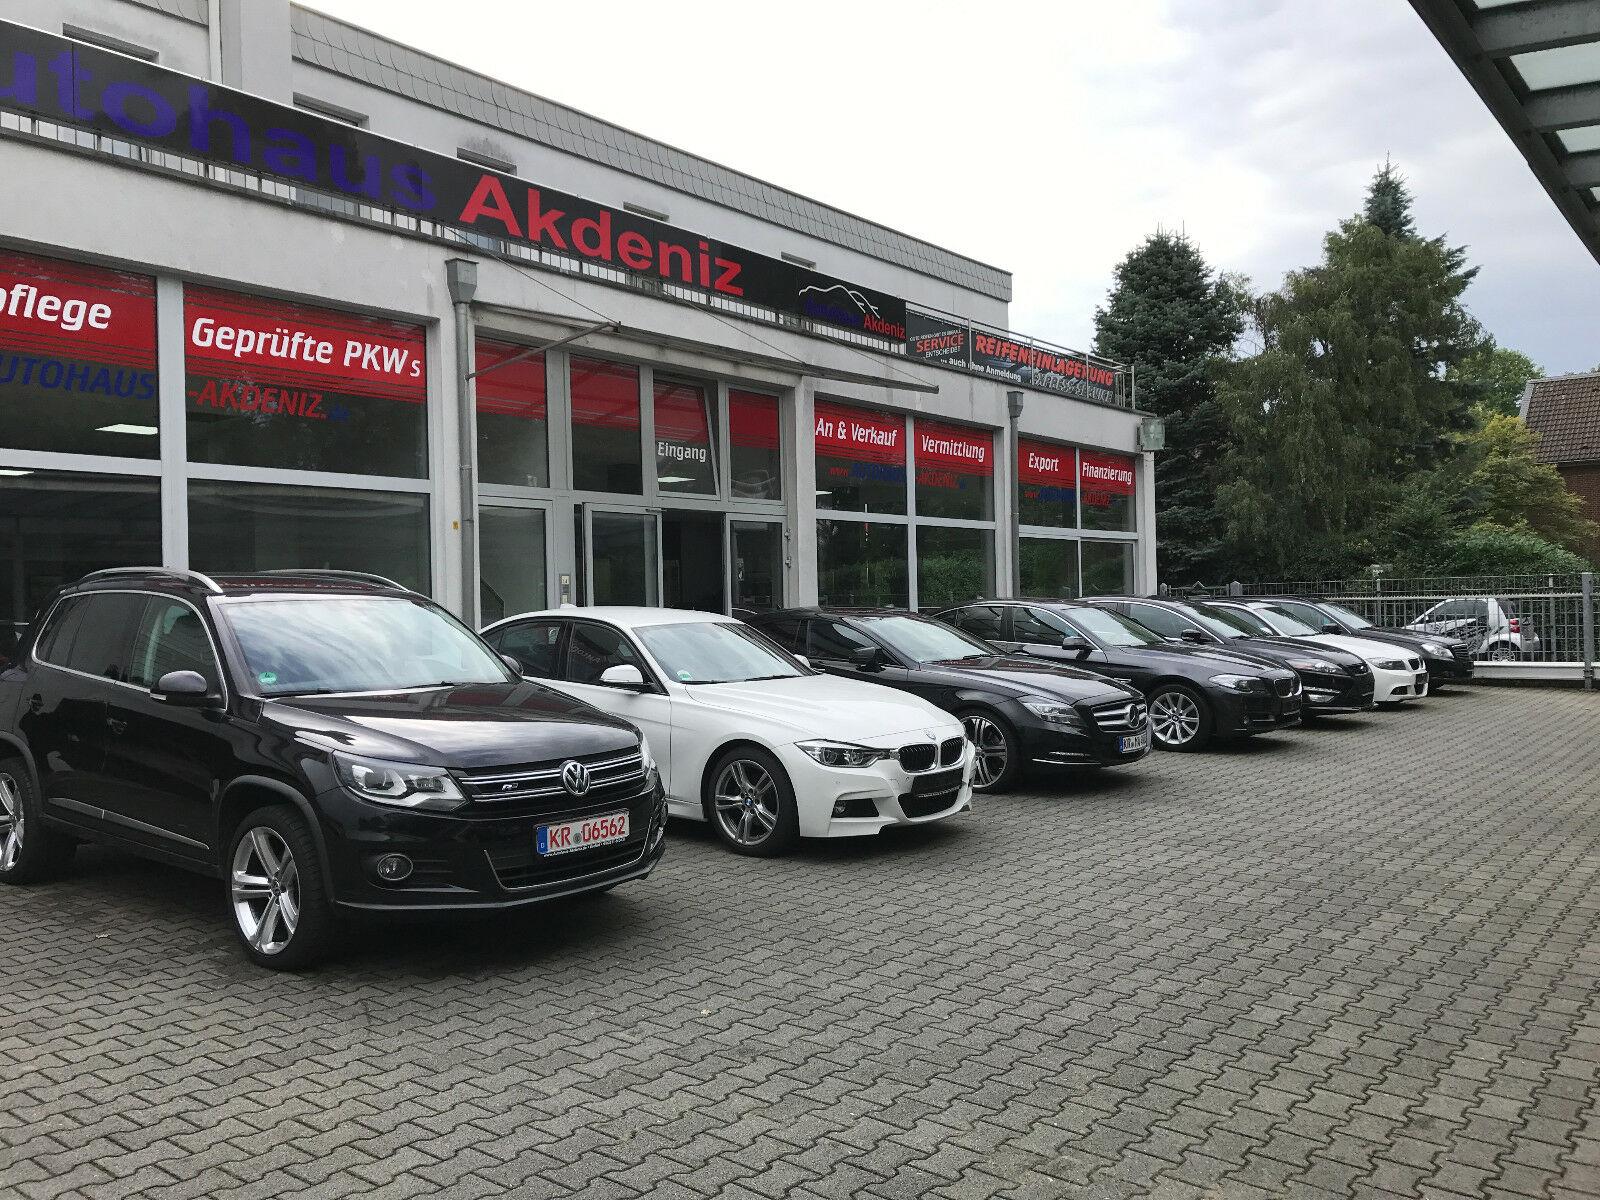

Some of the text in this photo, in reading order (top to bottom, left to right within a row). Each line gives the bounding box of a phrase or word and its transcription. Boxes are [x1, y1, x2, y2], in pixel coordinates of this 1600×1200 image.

[459, 175, 744, 297] Akdeniz
[864, 314, 906, 340] Akdeniz
[191, 317, 334, 364] Geprüfte
[915, 333, 965, 353] SERVICE
[948, 357, 967, 368] auch
[985, 364, 1022, 383] Anmeldung
[814, 417, 898, 448] An & Verkauf
[657, 441, 707, 463] Eingang
[921, 433, 985, 464] Vermittlung
[1028, 451, 1060, 474] Export
[1081, 461, 1133, 487] Finanzierung
[549, 826, 572, 849] KR
[582, 815, 626, 843] 06562
